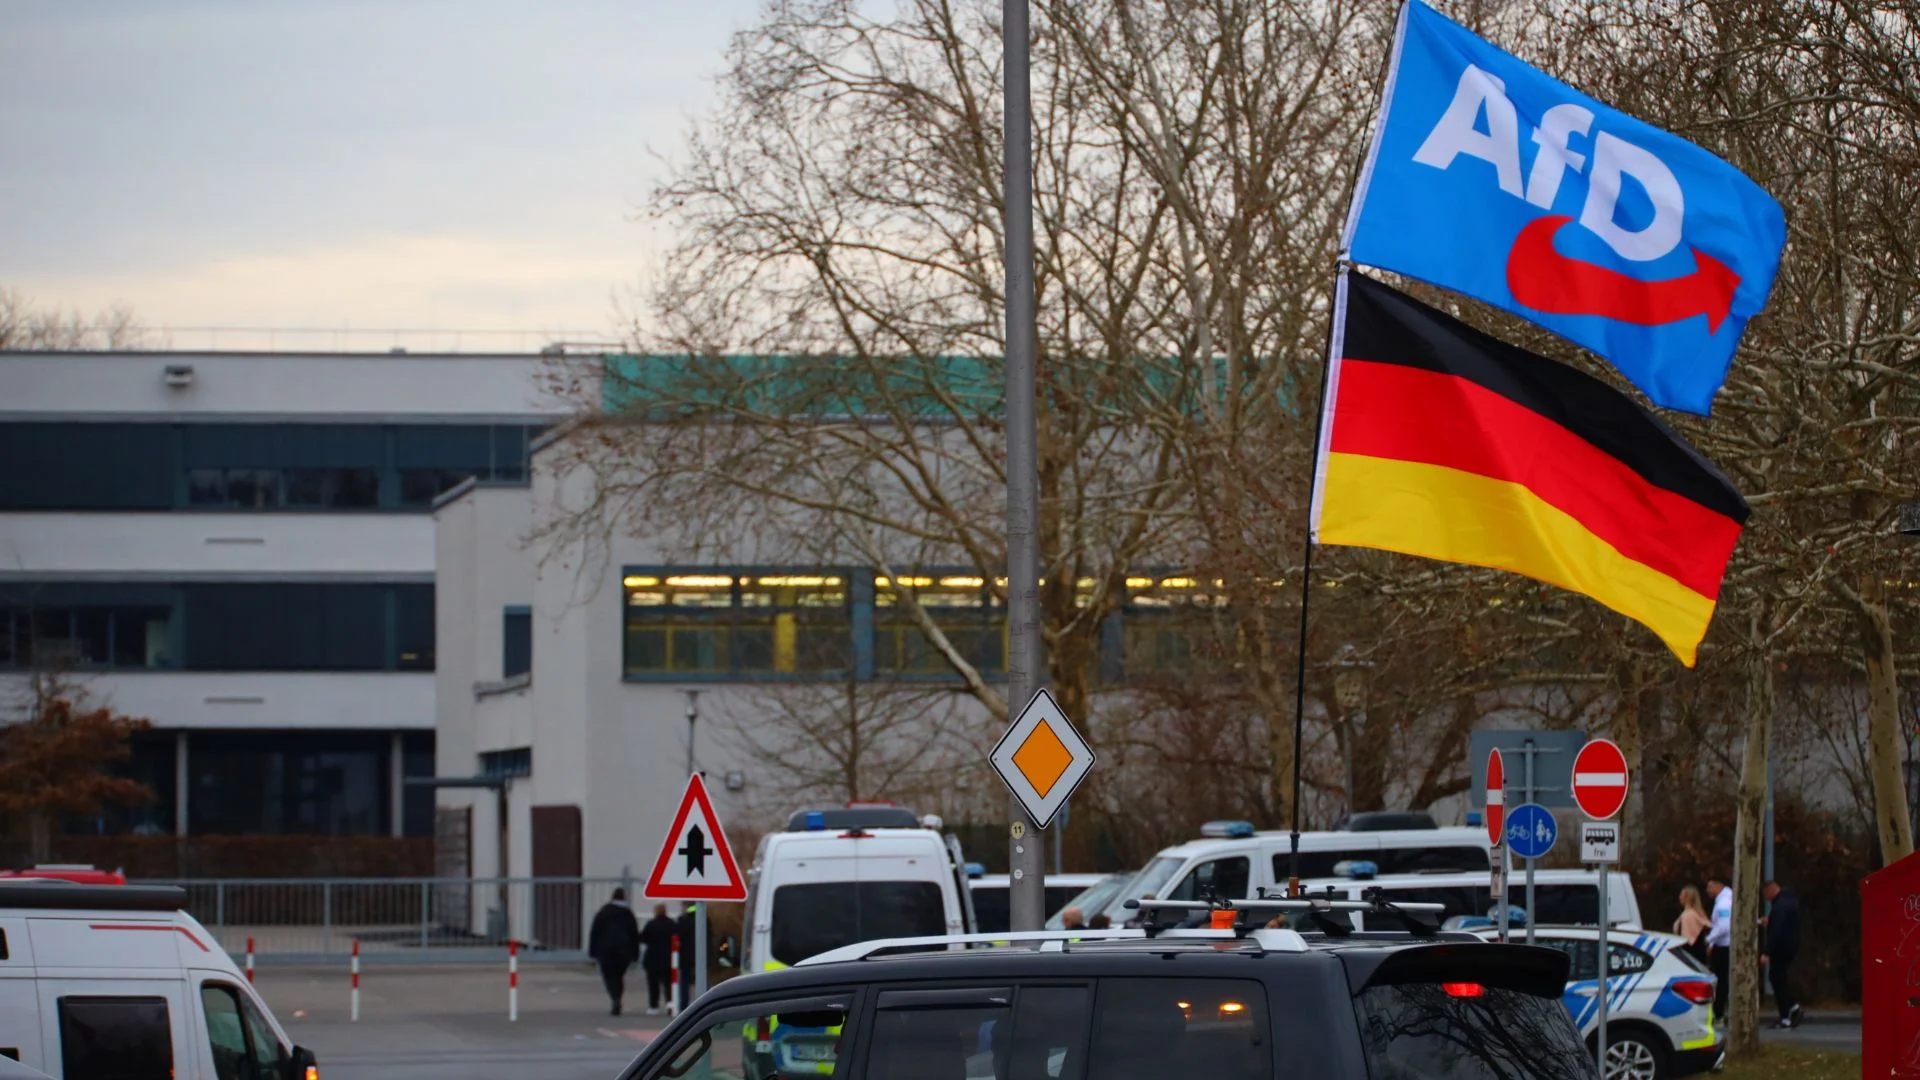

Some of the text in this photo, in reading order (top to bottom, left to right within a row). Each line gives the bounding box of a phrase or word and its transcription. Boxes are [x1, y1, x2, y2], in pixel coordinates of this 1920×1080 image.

[1412, 64, 1684, 261] AfD
[1014, 825, 1022, 834] 11
[1594, 847, 1607, 857] frei
[1623, 956, 1643, 968] 110
